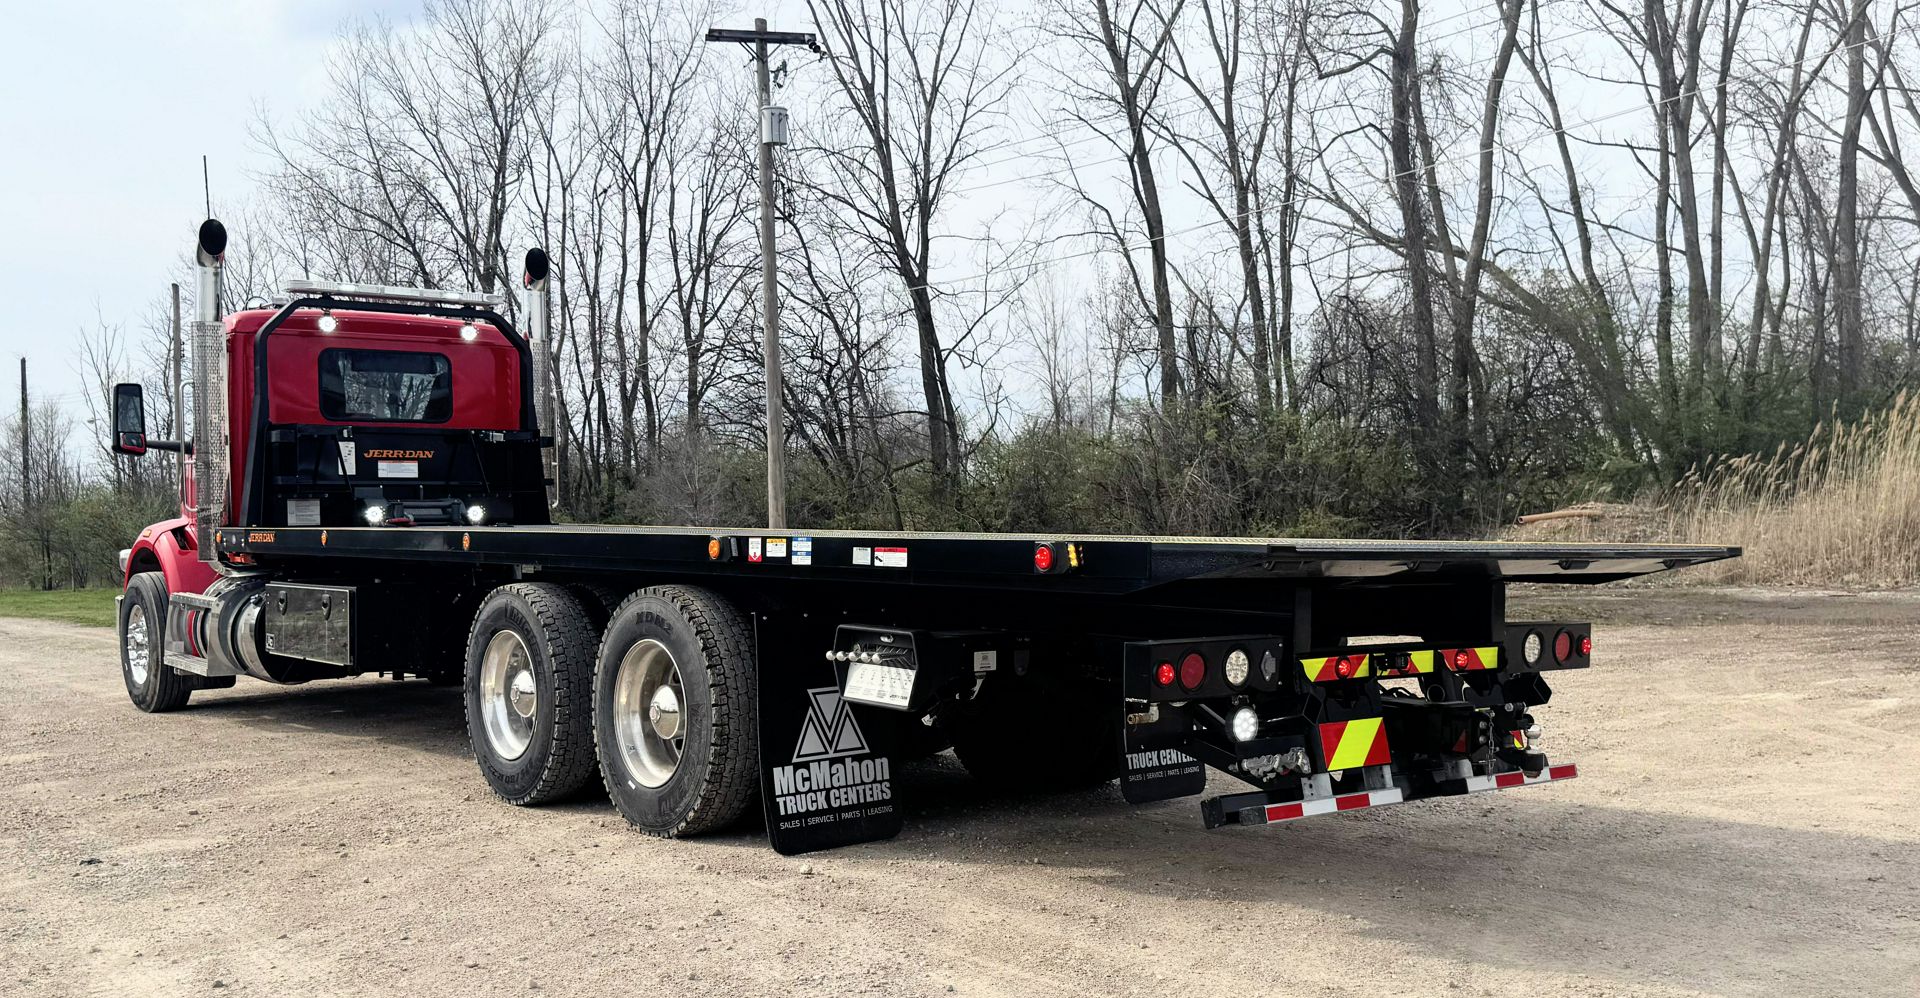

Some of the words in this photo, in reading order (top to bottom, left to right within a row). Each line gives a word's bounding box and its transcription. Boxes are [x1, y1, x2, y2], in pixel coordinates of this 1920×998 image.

[363, 449, 435, 459] JERR-DAN
[1125, 751, 1159, 770] TRUCK
[1160, 748, 1197, 766] CENTE
[773, 757, 890, 796] McMahon
[776, 790, 828, 816] TRUCK
[829, 782, 891, 808] CENTERS
[780, 819, 801, 830] SALES
[807, 814, 835, 826] SERVICE
[841, 810, 861, 820] PARTS
[867, 805, 893, 816] LEASING
